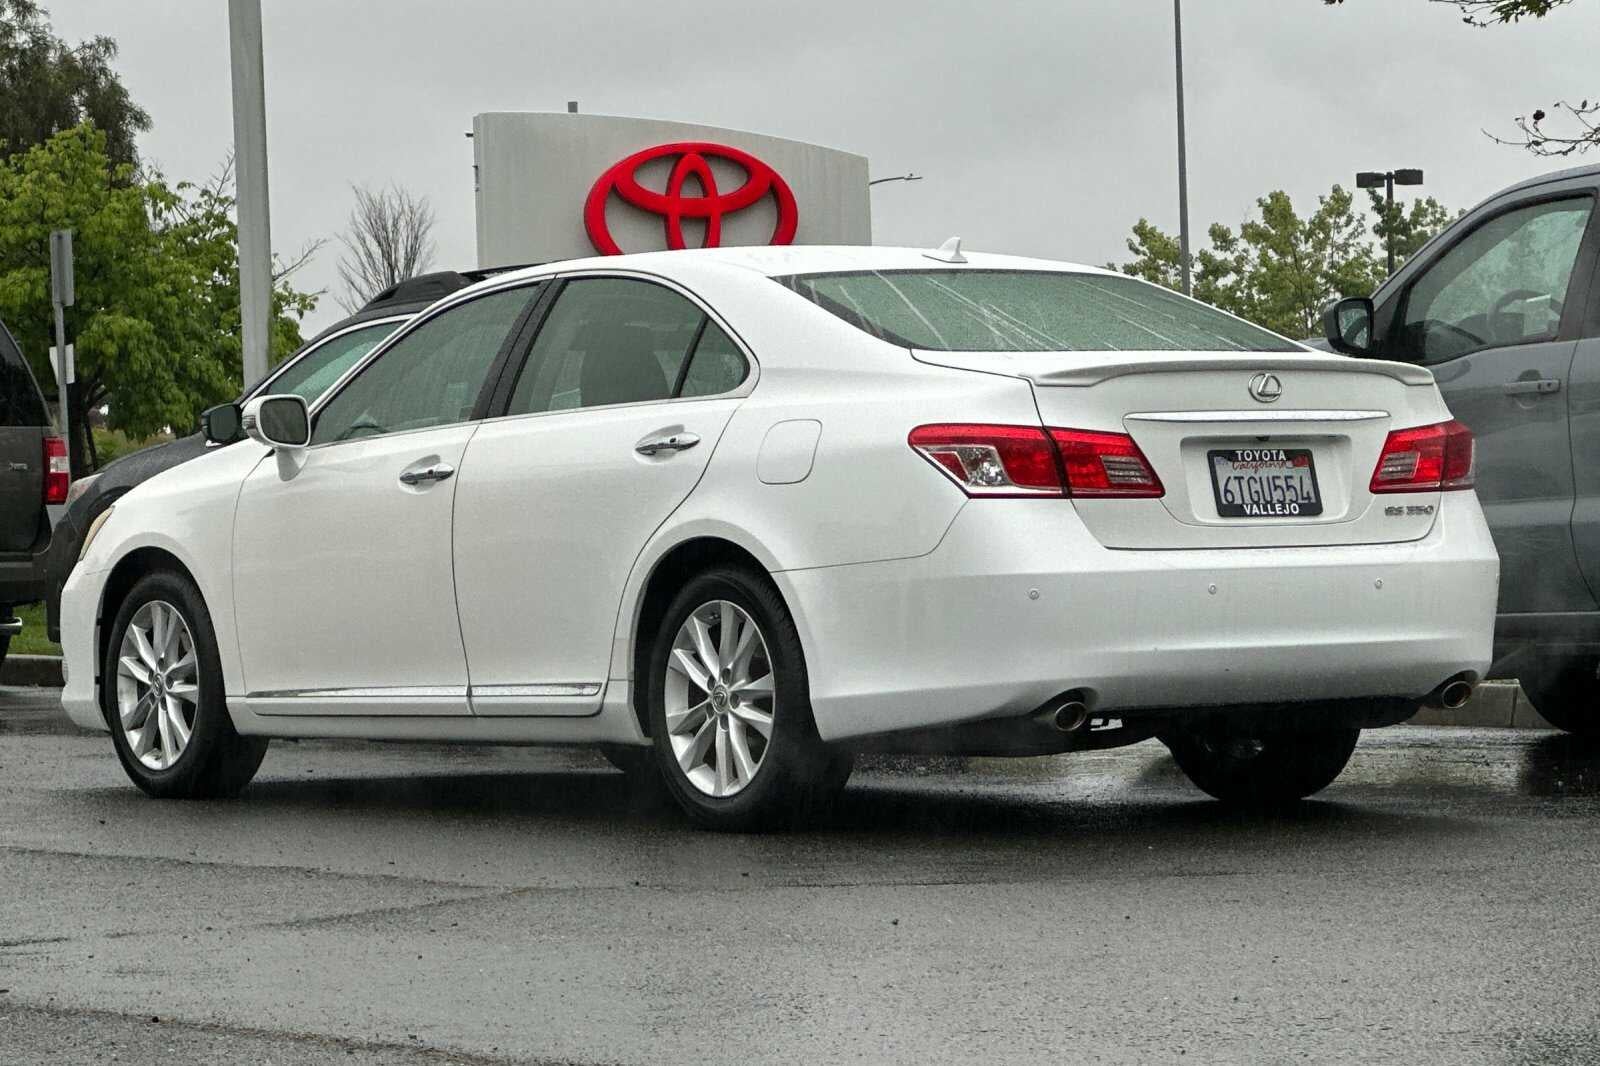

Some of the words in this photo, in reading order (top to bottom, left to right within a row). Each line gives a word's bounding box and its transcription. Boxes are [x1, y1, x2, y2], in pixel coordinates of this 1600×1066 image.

[1235, 450, 1287, 461] TOYOTA
[1223, 476, 1312, 504] 6TGU554
[1243, 503, 1300, 515] VALLEJO
